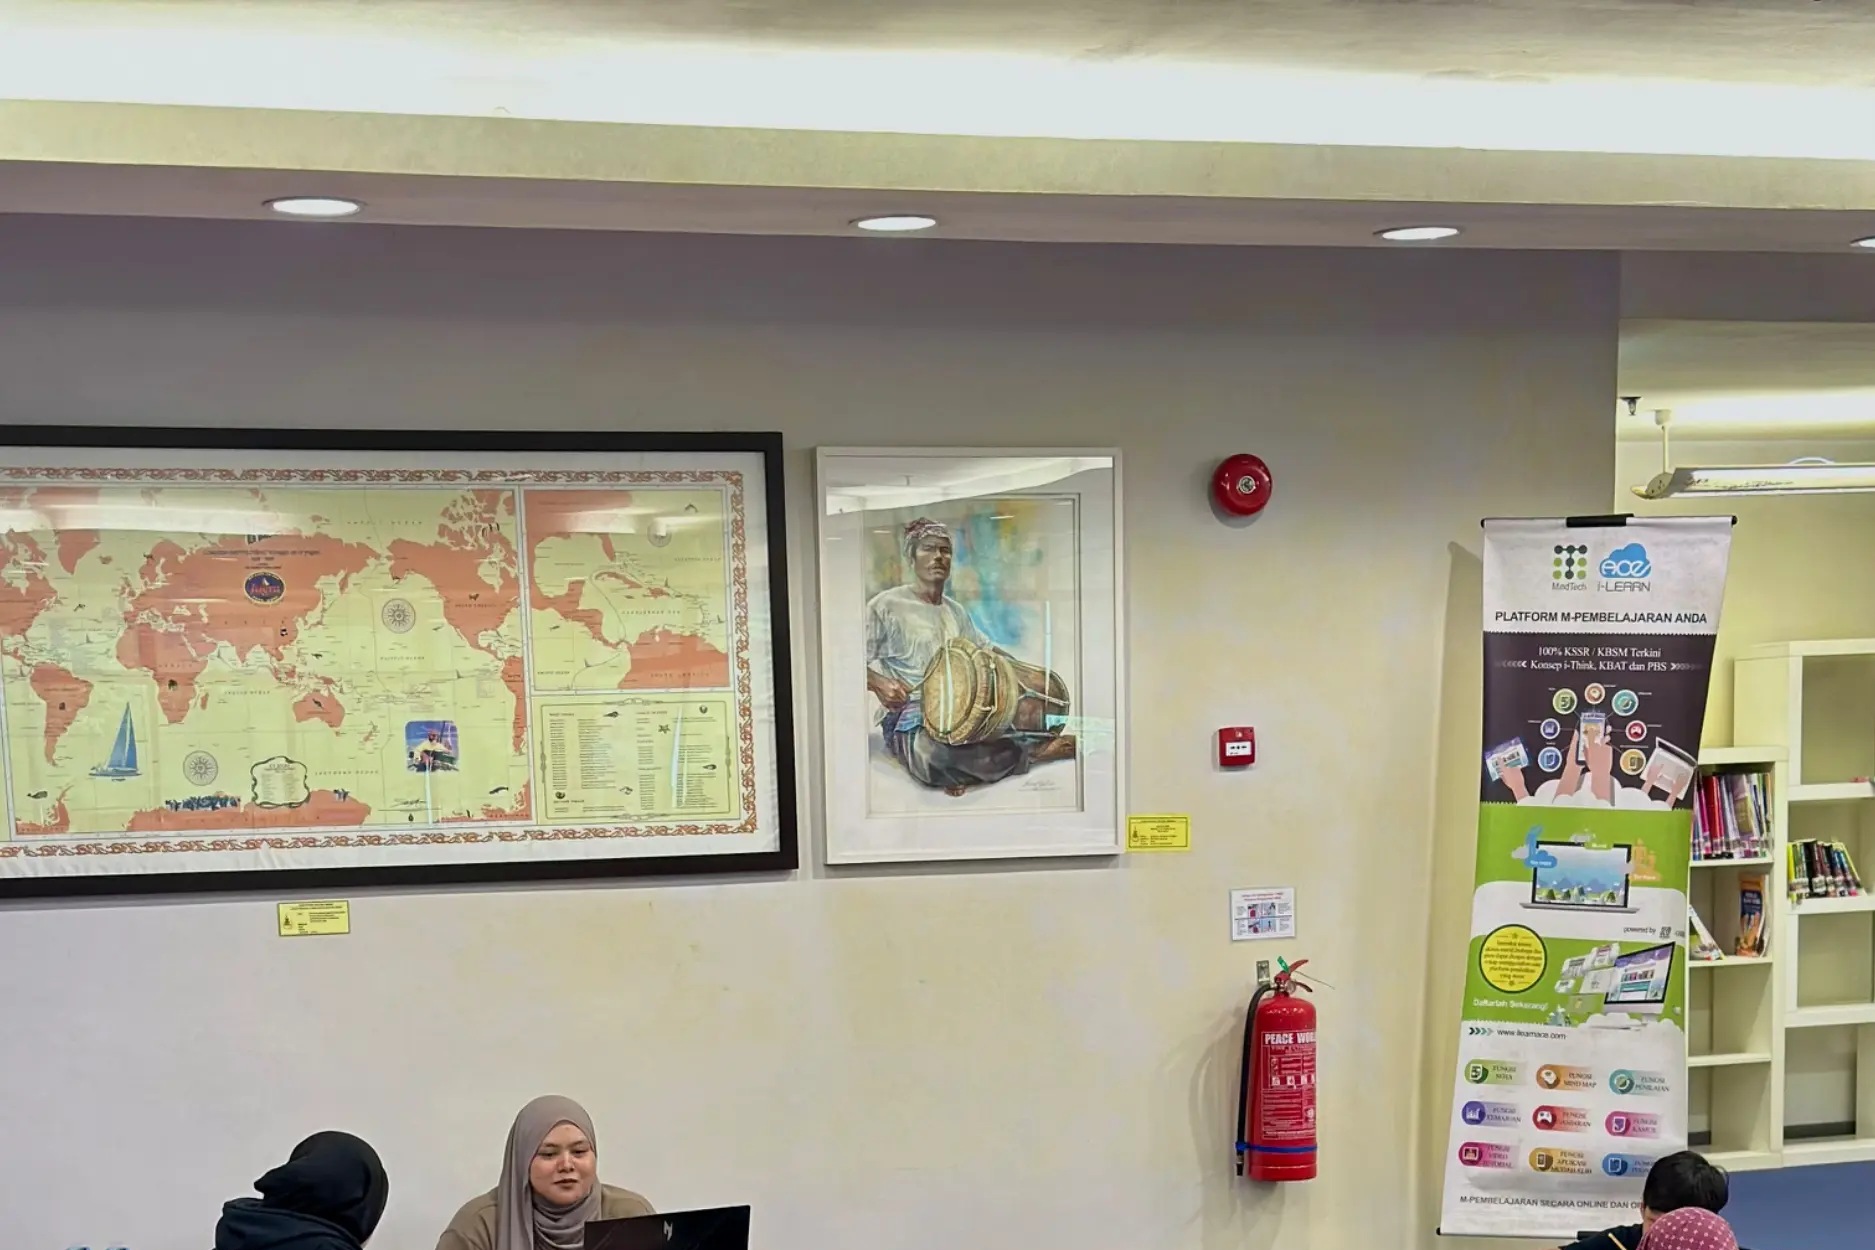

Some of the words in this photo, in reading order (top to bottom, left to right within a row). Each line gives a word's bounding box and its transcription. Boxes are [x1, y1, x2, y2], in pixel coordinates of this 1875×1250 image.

[1495, 611, 1557, 622] PLATFORM
[1561, 612, 1672, 623] M-PEMBELAJARAN
[1675, 613, 1707, 623] ANDA
[1538, 646, 1562, 656] 100%
[1564, 647, 1589, 657] KSSR
[1597, 647, 1628, 657] KBSM
[1630, 647, 1661, 657] Terkini
[1530, 660, 1562, 671] Konsep
[1599, 661, 1628, 671] KBAT
[1629, 661, 1645, 671] dan
[1647, 662, 1667, 671] PBS
[1265, 1033, 1294, 1044] PEACE
[1540, 1199, 1574, 1208] SECARA
[1576, 1200, 1608, 1208] ONLINE
